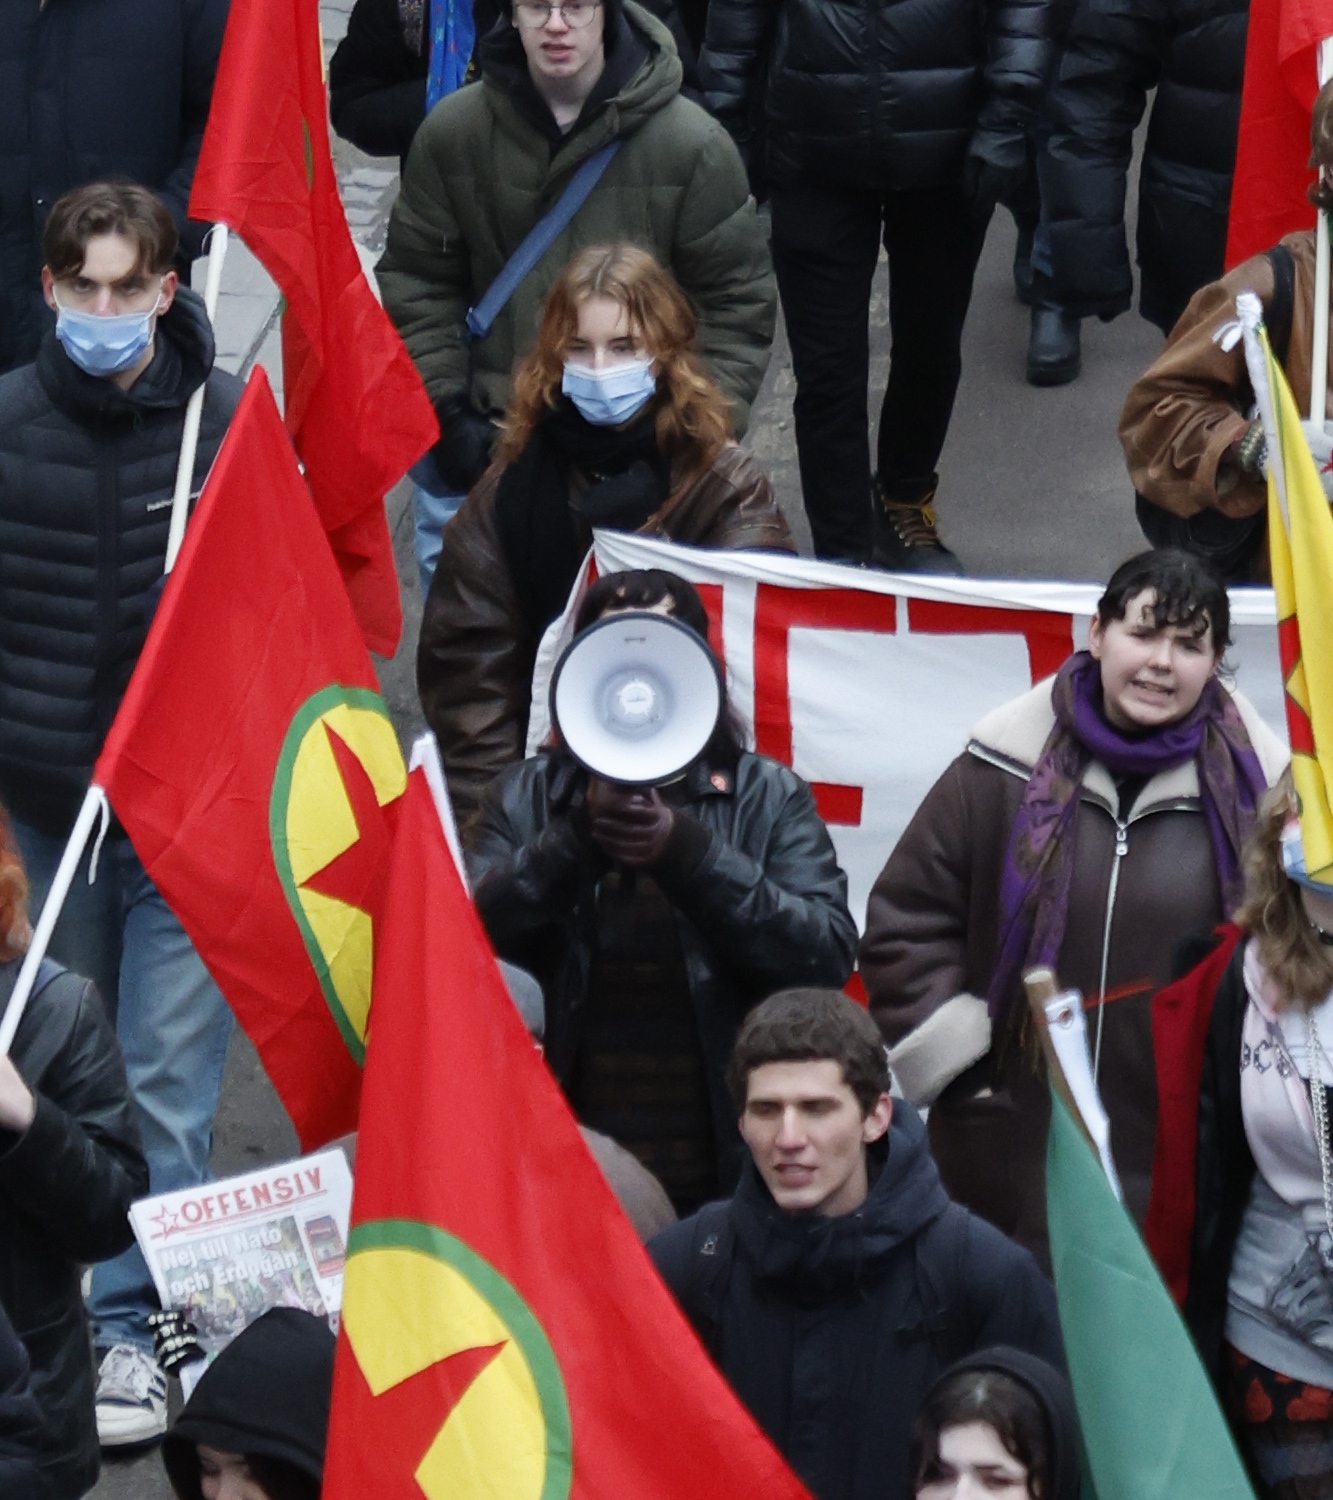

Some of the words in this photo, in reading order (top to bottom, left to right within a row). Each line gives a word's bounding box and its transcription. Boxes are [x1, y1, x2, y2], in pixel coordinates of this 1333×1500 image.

[180, 1166, 322, 1224] OFFENSIV
[160, 1245, 200, 1270] Nej
[202, 1236, 230, 1261] till
[233, 1226, 283, 1253] Nato
[169, 1270, 210, 1297] och
